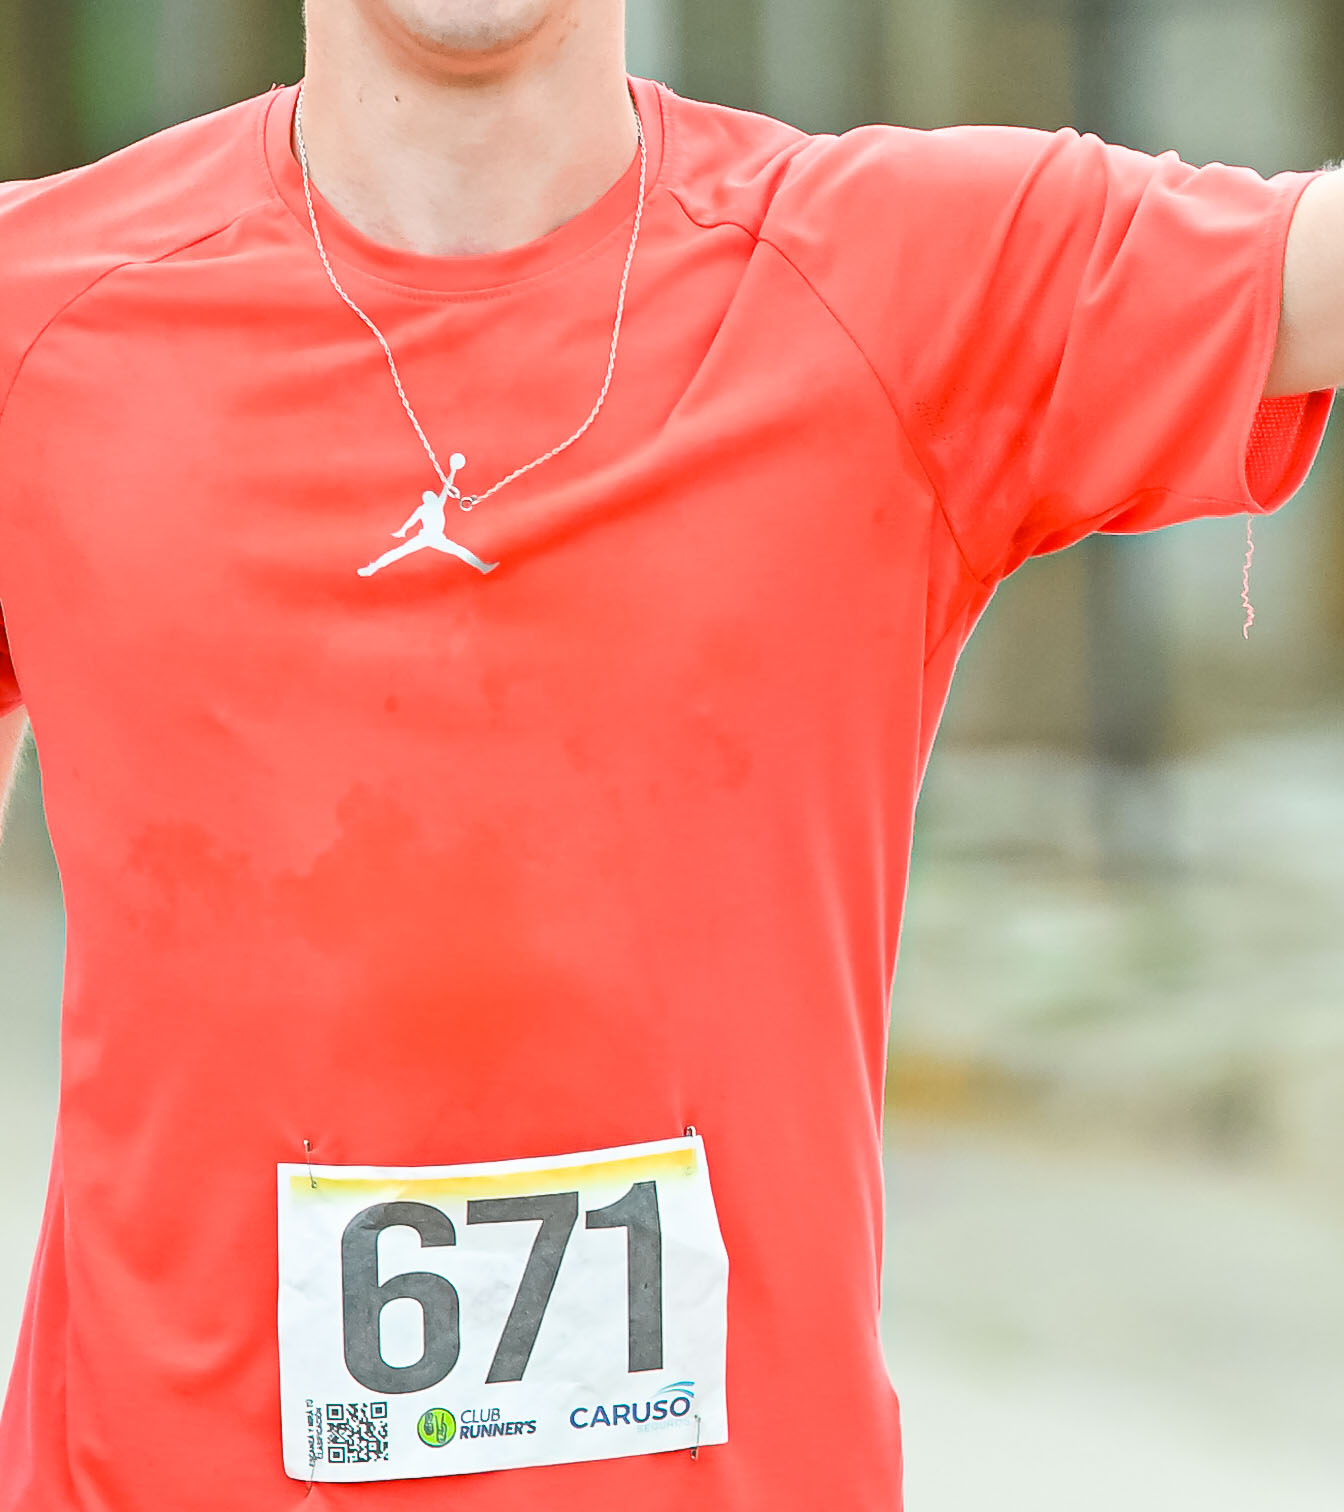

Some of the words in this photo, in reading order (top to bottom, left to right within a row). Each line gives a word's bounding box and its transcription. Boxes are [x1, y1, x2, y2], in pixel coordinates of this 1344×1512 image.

[341, 1181, 663, 1394] 671
[460, 1408, 501, 1424] CLUB
[569, 1396, 691, 1429] CARUSO
[459, 1420, 537, 1439] RUNNER'S
